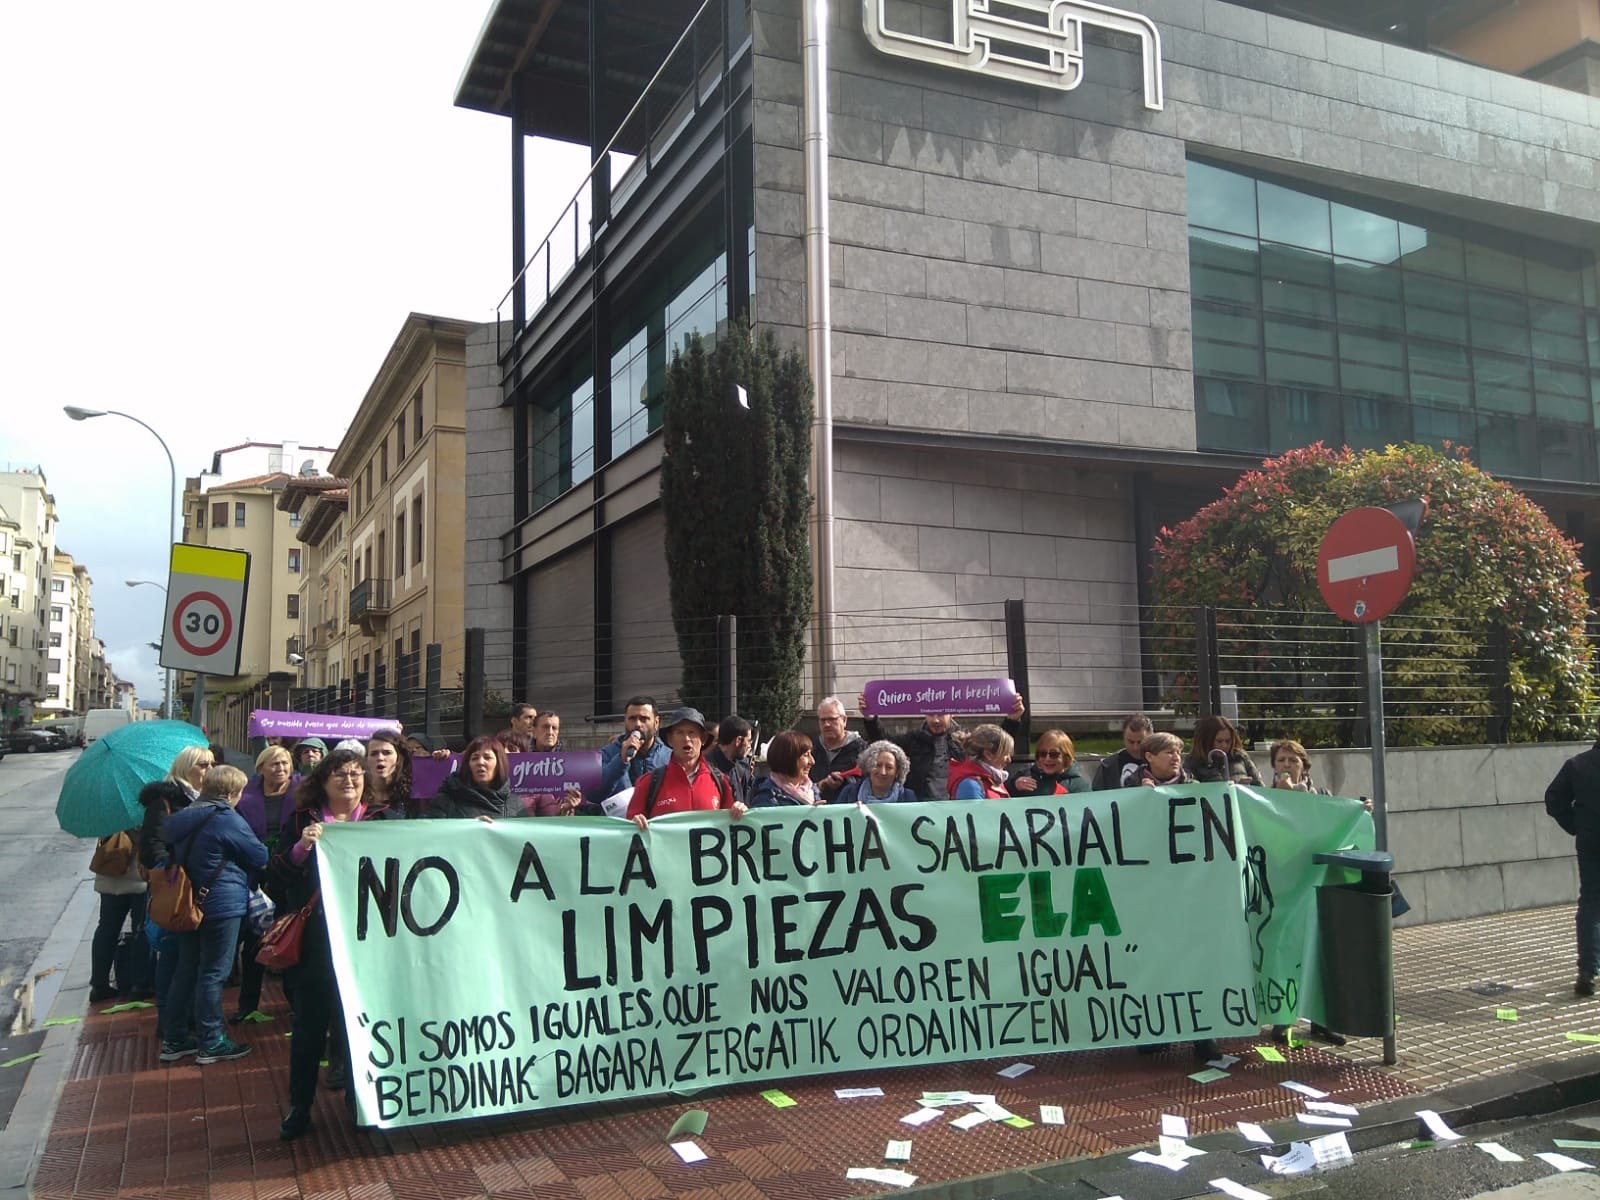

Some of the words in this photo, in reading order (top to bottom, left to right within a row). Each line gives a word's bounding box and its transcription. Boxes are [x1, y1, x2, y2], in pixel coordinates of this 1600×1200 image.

[185, 612, 220, 634] 30
[877, 689, 912, 707] Quiero
[915, 687, 947, 703] saltar
[951, 685, 962, 701] la
[965, 684, 1000, 700] brecha
[513, 757, 565, 787] gratis
[357, 856, 461, 941] NO
[510, 842, 556, 903] A
[580, 833, 658, 896] LA
[688, 815, 890, 887] BRECHA
[911, 801, 1149, 873] SALARIAL
[1168, 796, 1238, 865] EN
[562, 883, 938, 992] LIMPIEZAS
[977, 867, 1122, 943] ELA
[419, 1011, 516, 1063] SOMOS
[750, 973, 808, 1015] NOS
[832, 955, 988, 1006] VALOREN
[674, 1016, 840, 1083] ZERGATIK
[856, 995, 1069, 1059] ORDAINTZEN
[1088, 989, 1212, 1042] DIGUTE
